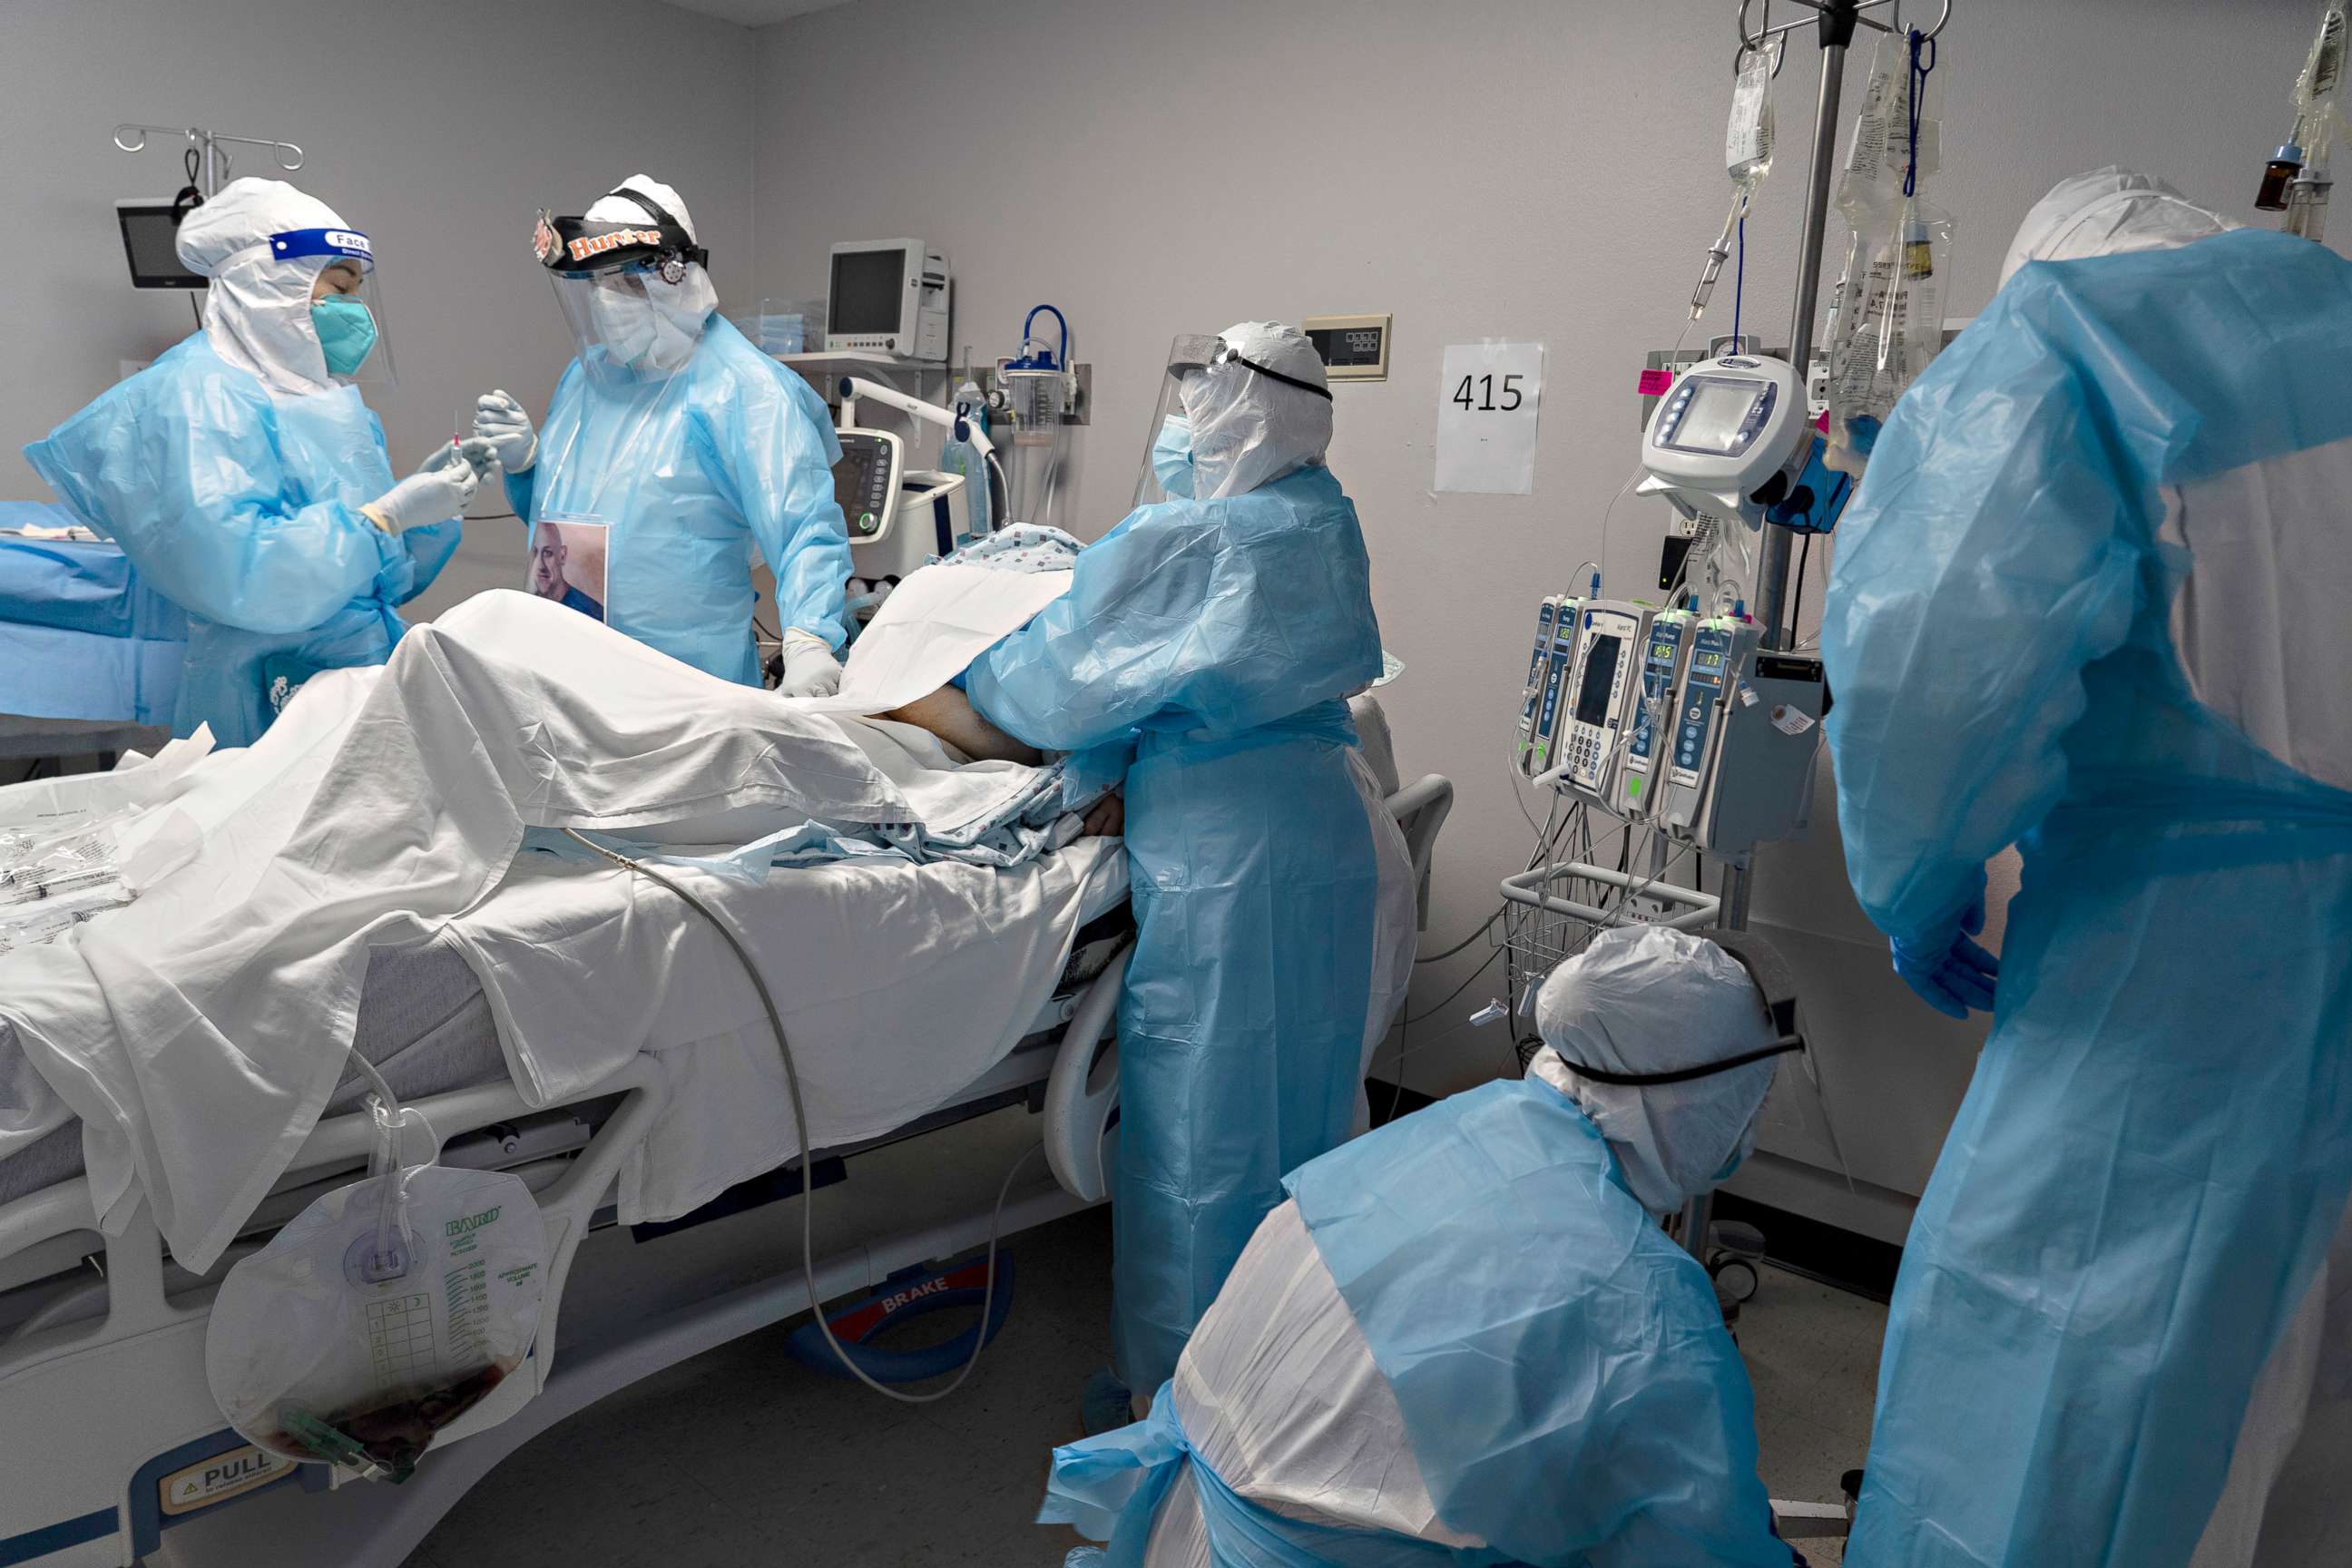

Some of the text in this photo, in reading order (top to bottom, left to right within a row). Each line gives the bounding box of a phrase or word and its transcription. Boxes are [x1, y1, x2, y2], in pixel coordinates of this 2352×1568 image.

[337, 234, 365, 249] Face
[568, 229, 662, 261] Hunter
[1453, 374, 1524, 411] 415
[446, 1208, 501, 1236] BARD
[881, 1277, 950, 1314] BRAKE
[204, 1454, 270, 1486] PULL
